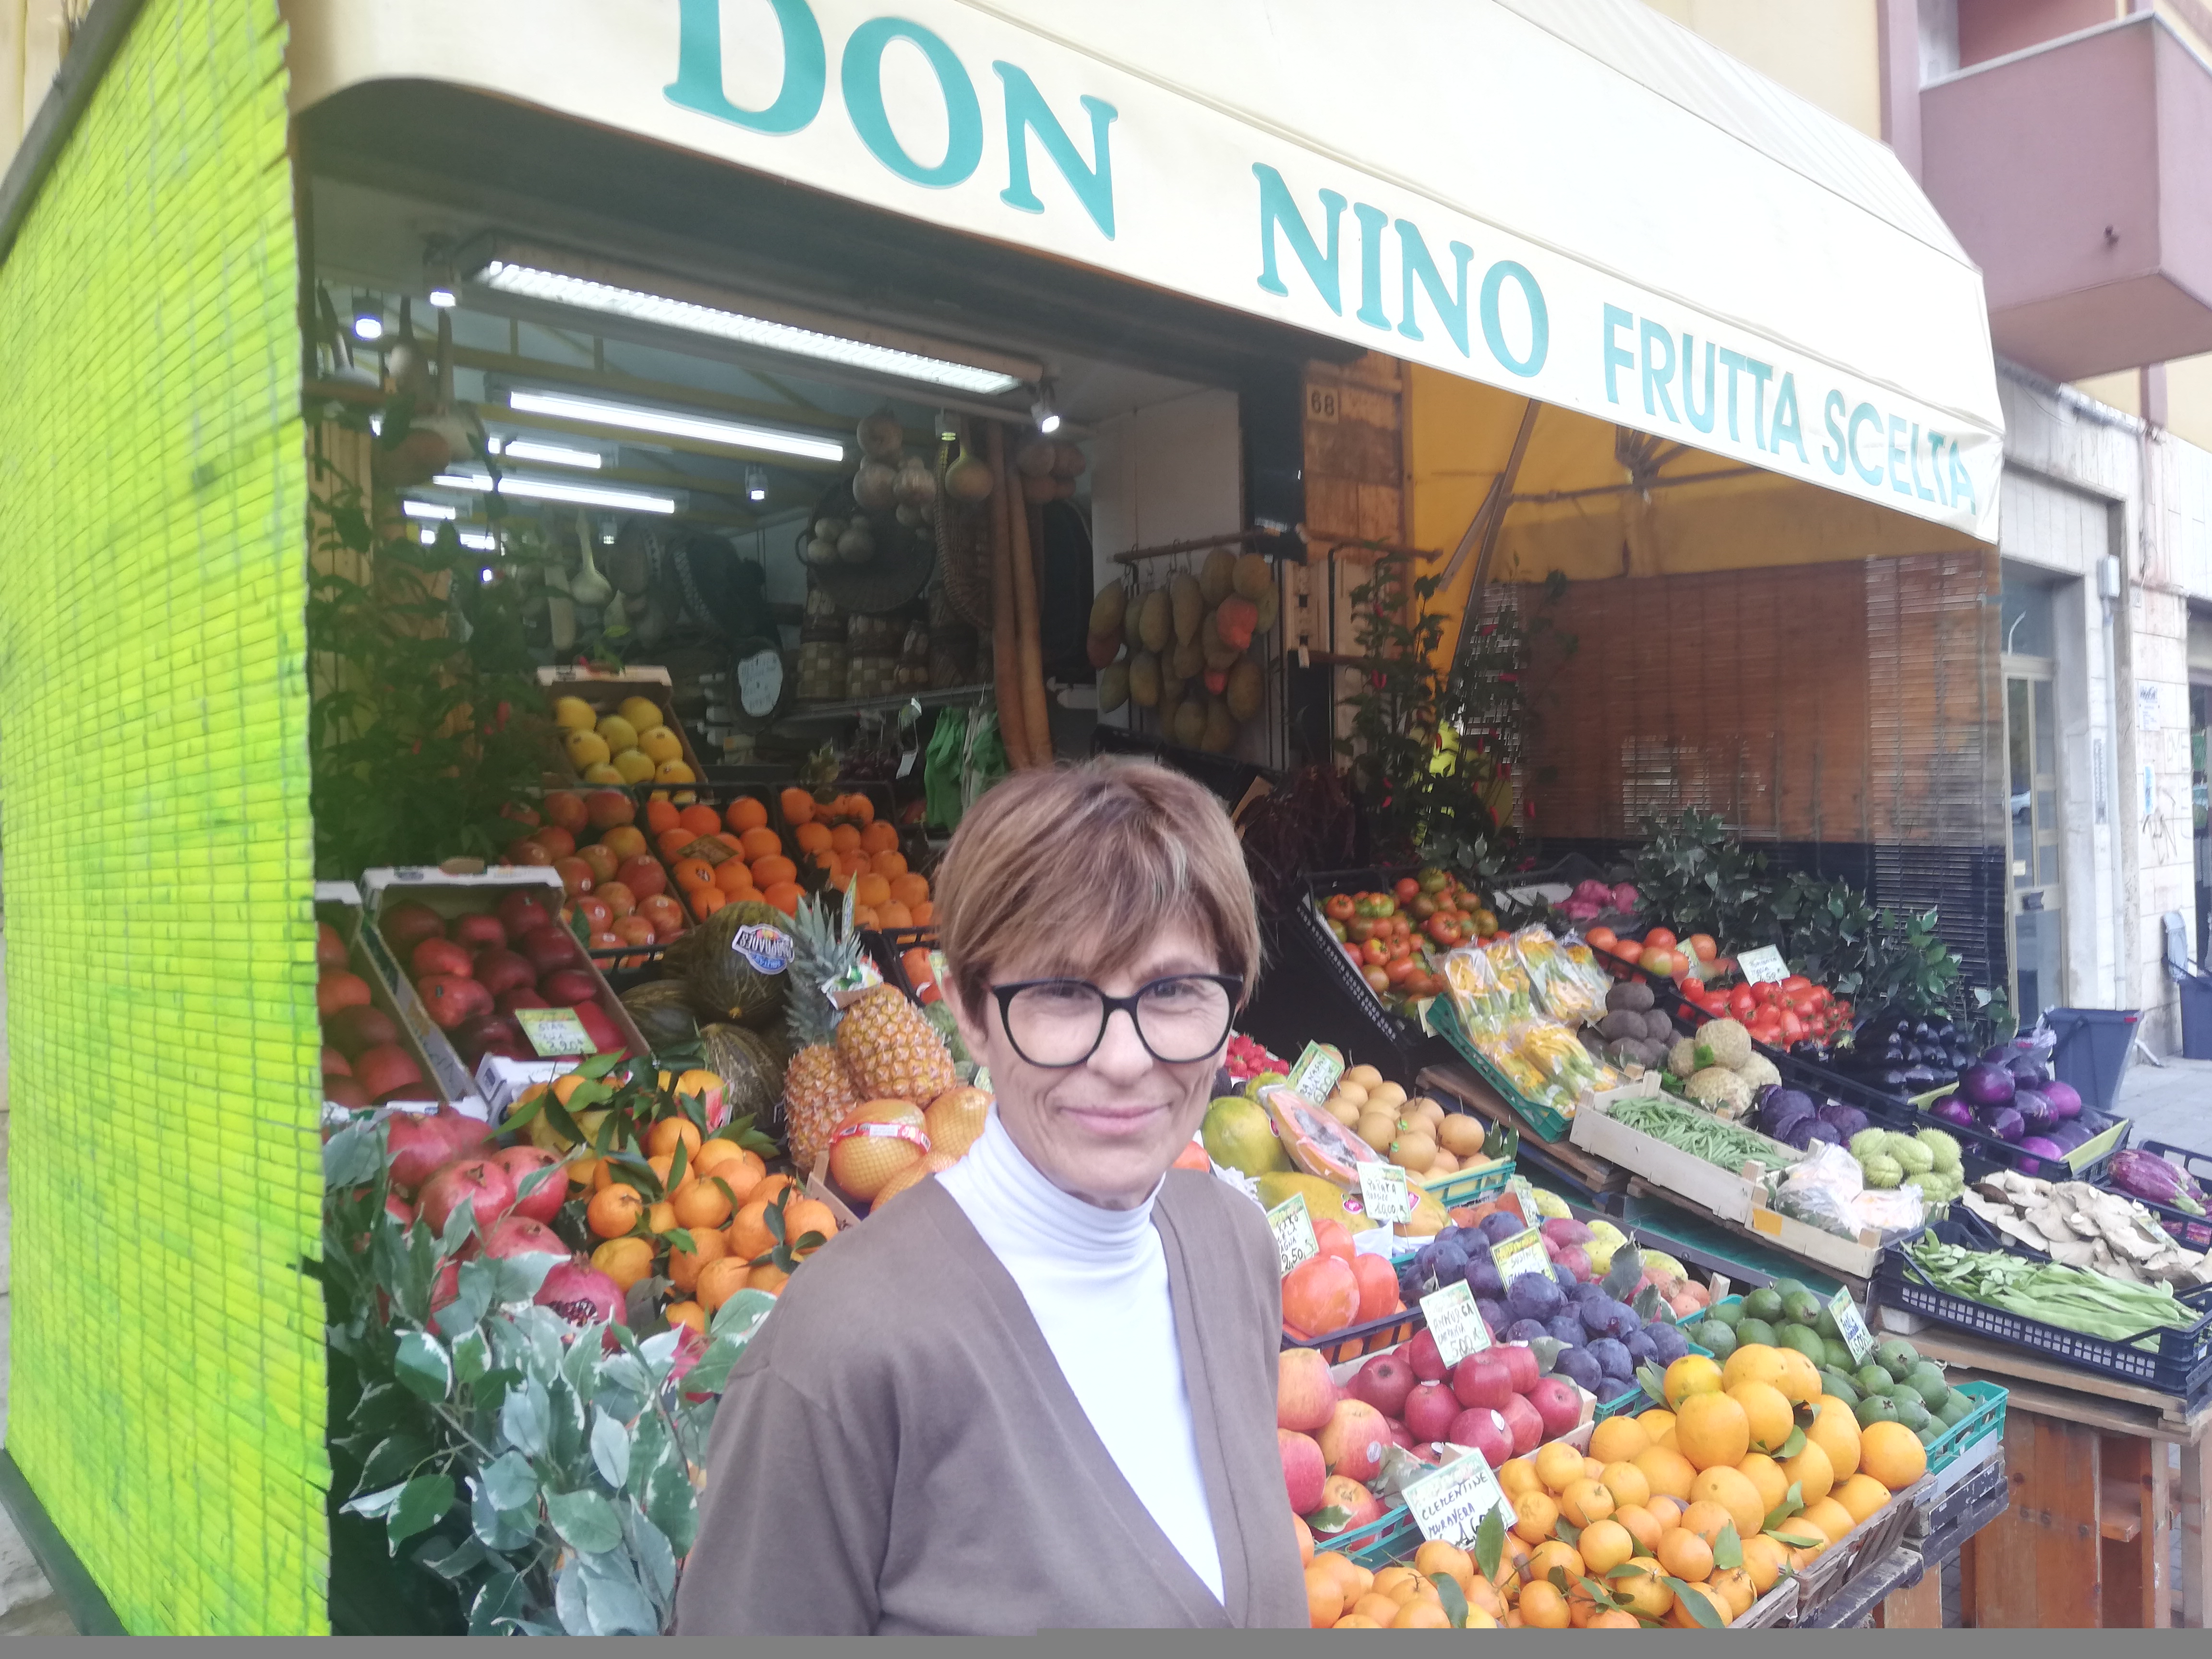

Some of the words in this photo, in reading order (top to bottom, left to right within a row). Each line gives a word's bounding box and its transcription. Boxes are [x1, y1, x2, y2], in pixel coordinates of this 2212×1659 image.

[662, 0, 1118, 241] DON
[1251, 162, 1549, 378] NINO
[1603, 302, 1810, 465] FRUTTA
[1822, 389, 1976, 516] SCELTA
[1311, 390, 1334, 417] 68
[1281, 1236, 1297, 1254] AGNA
[1422, 1472, 1488, 1521] CLEMENTINE
[1428, 1502, 1476, 1540] MURAVERA
